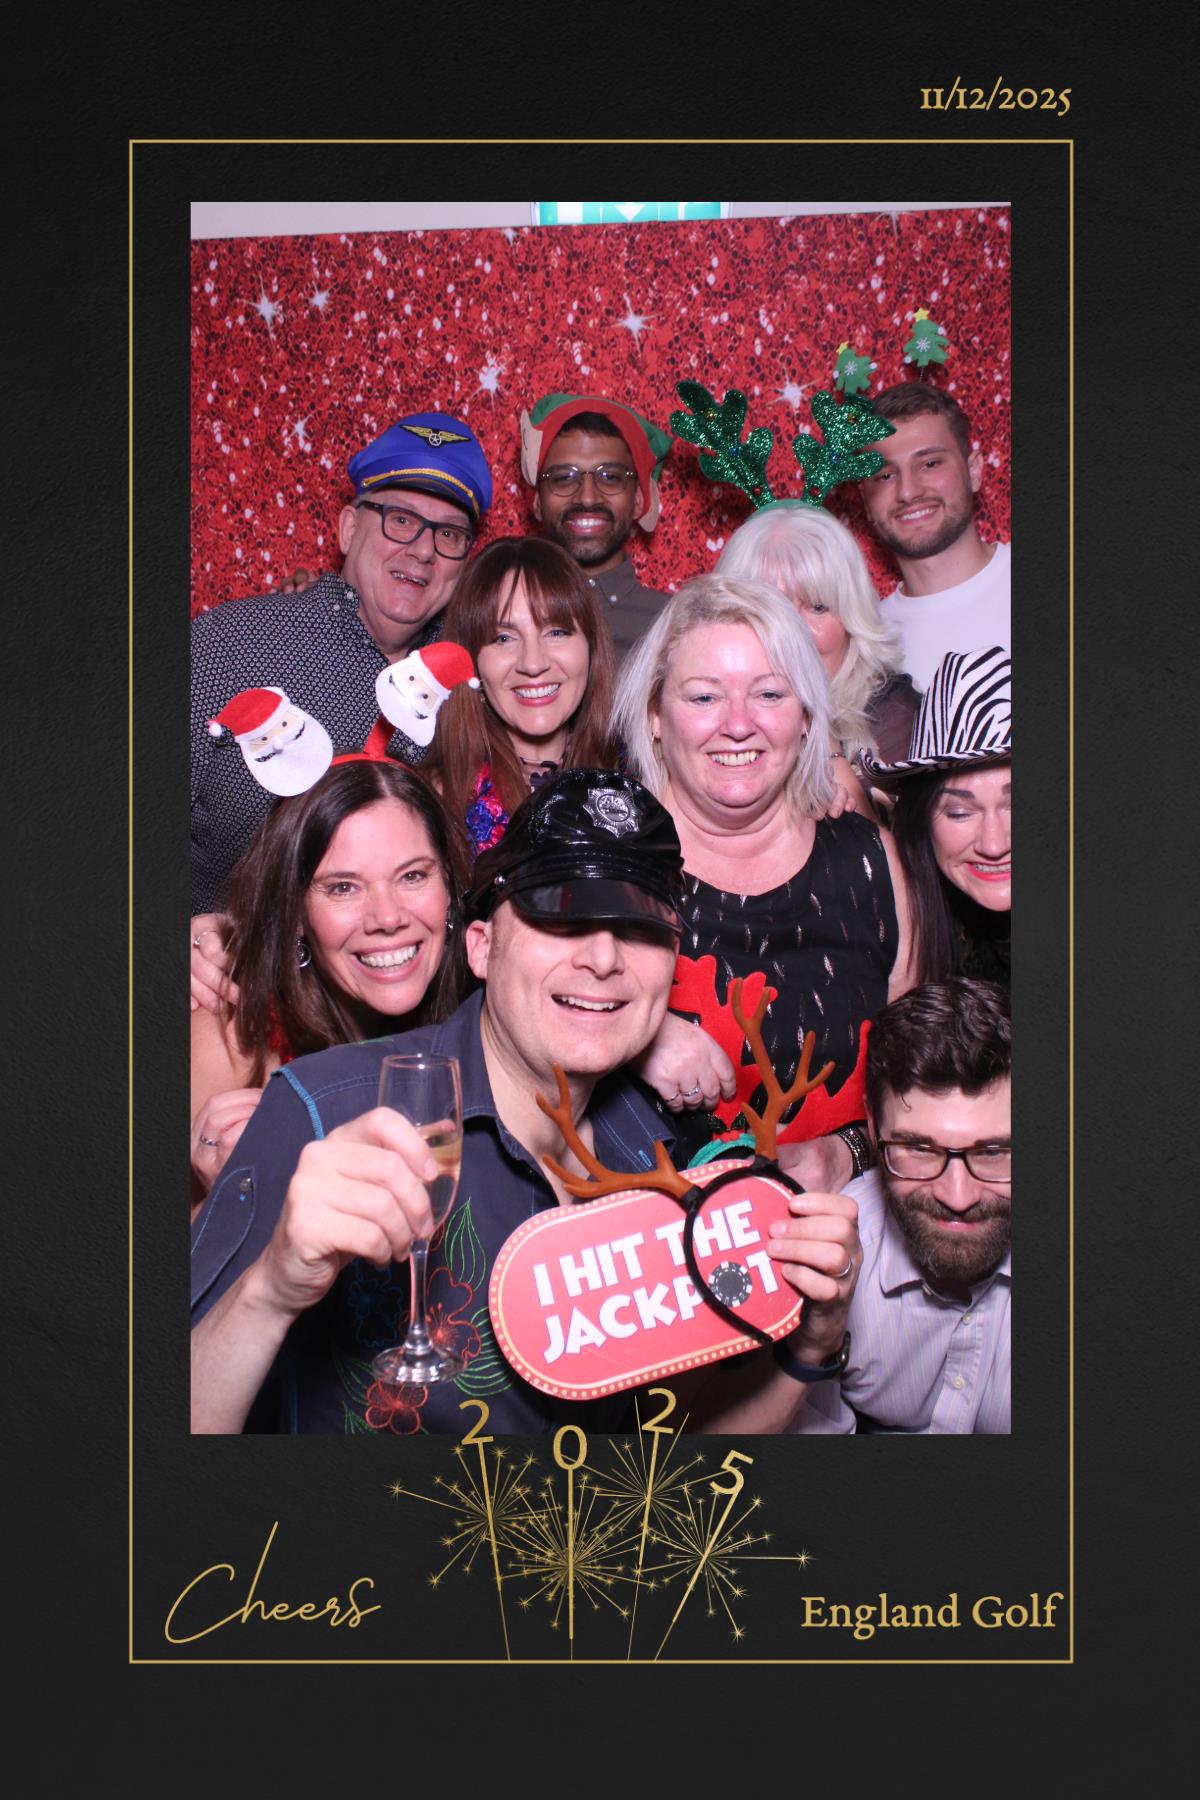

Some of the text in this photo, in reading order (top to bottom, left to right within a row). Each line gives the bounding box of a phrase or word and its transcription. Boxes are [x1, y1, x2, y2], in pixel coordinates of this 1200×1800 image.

[531, 1199, 761, 1307] I HIT THE
